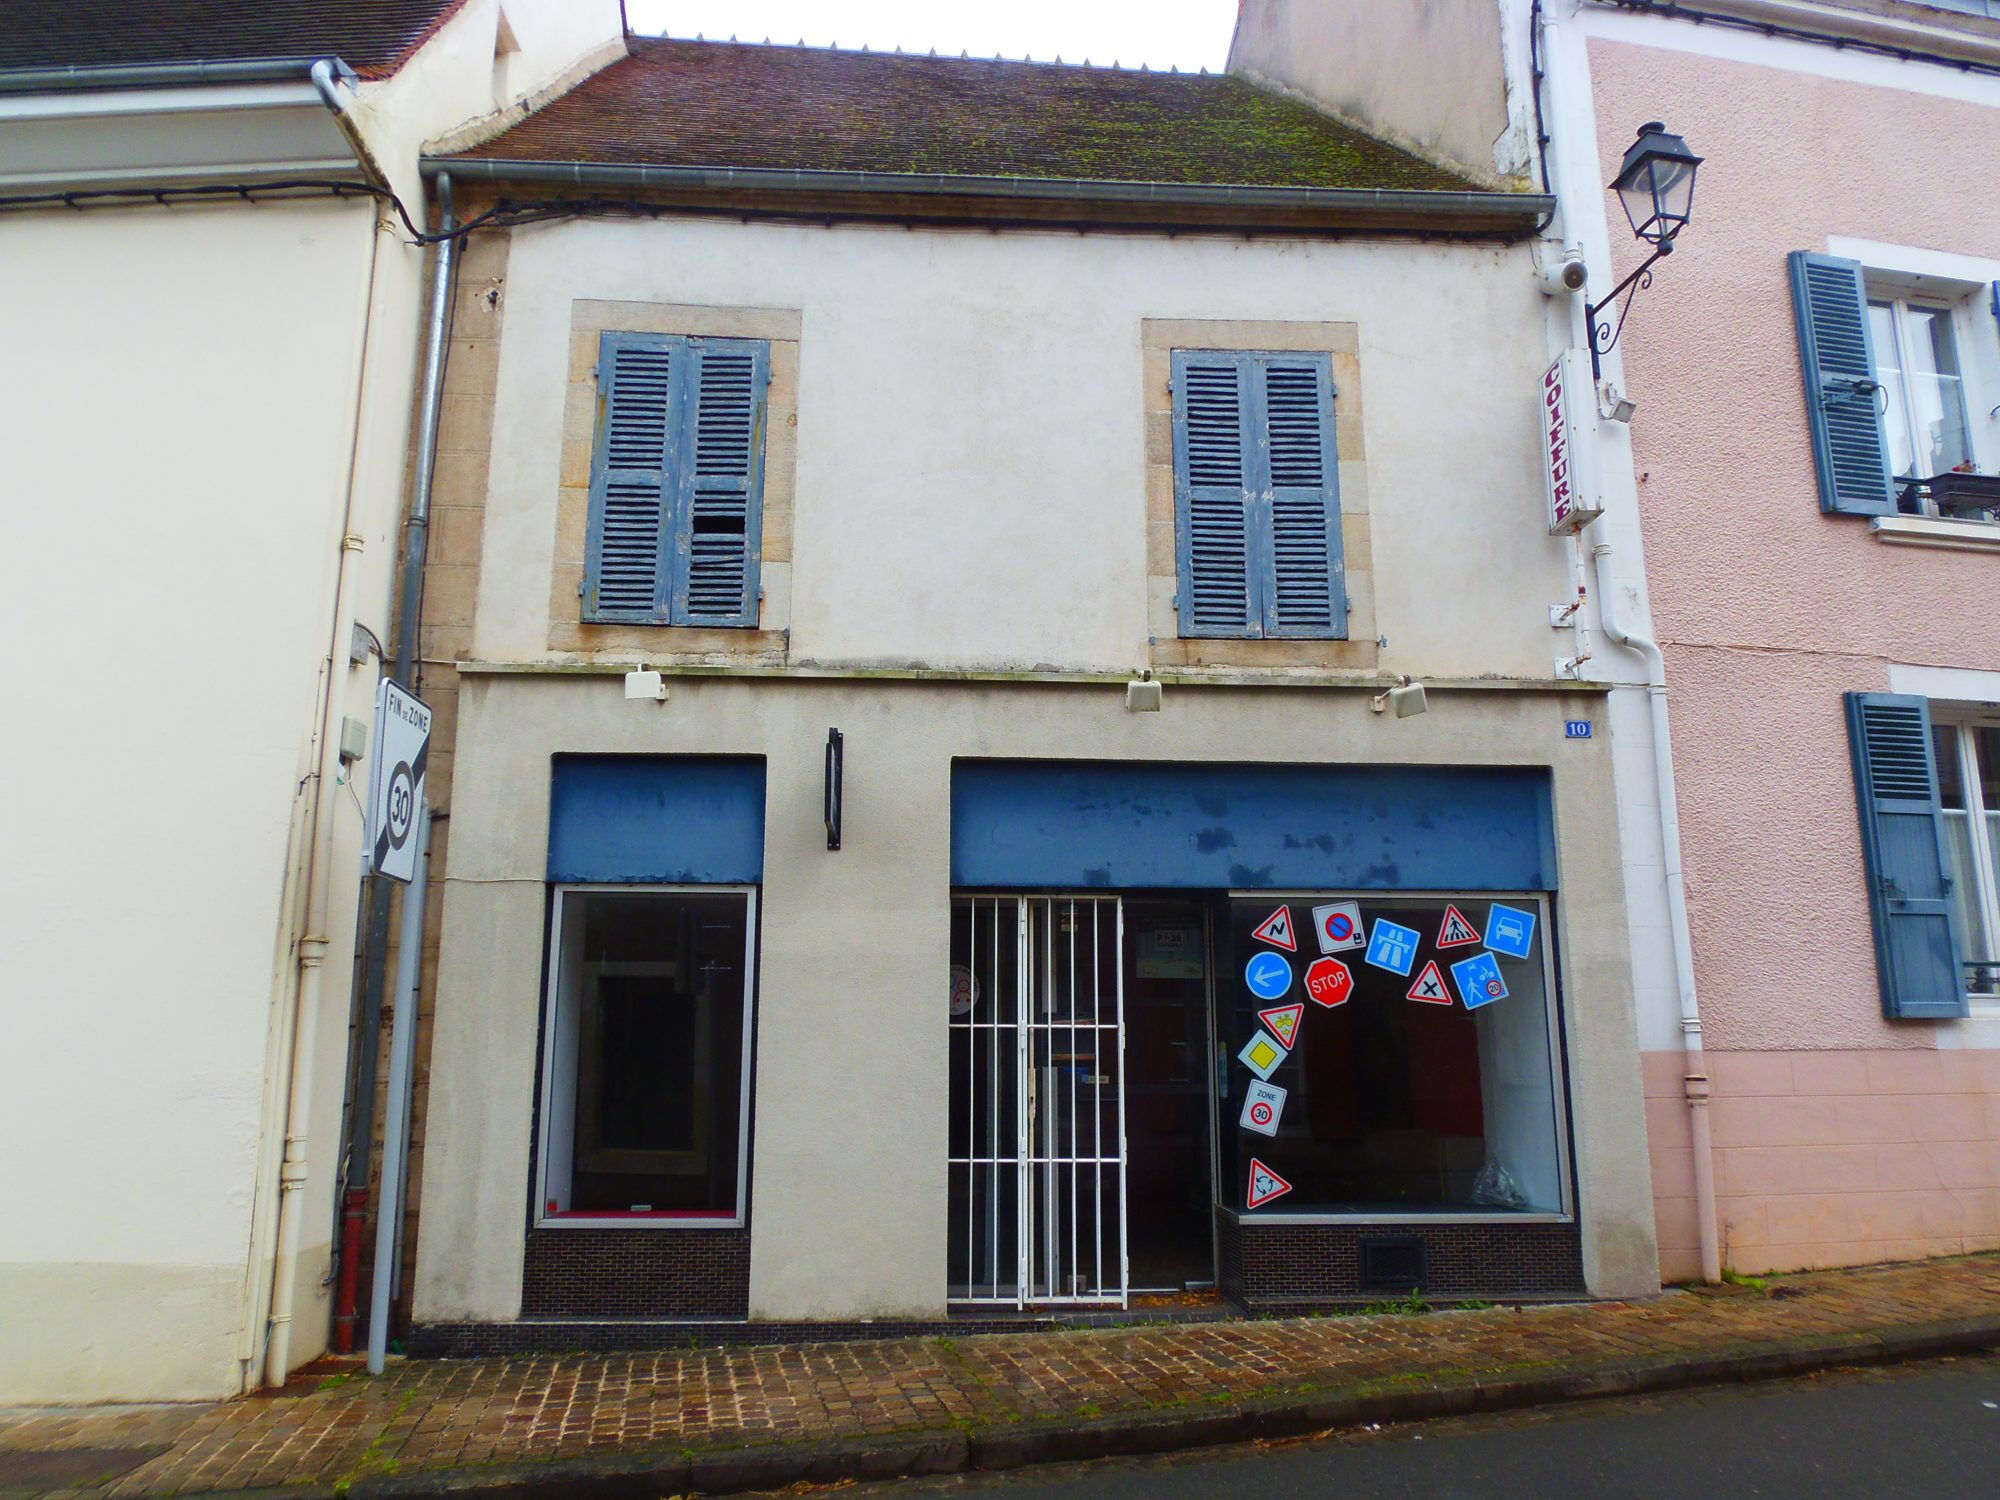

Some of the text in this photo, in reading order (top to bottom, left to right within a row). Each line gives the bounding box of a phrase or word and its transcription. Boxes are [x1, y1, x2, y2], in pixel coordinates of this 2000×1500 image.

[1544, 362, 1571, 525] COIFFURE
[389, 693, 402, 717] FIN
[409, 706, 428, 733] ZONE
[1570, 723, 1586, 735] 10
[392, 786, 409, 826] 30
[1311, 971, 1346, 994] STOP
[1489, 983, 1500, 993] 20
[1257, 1089, 1276, 1102] ZONE
[1254, 1108, 1268, 1120] 30
